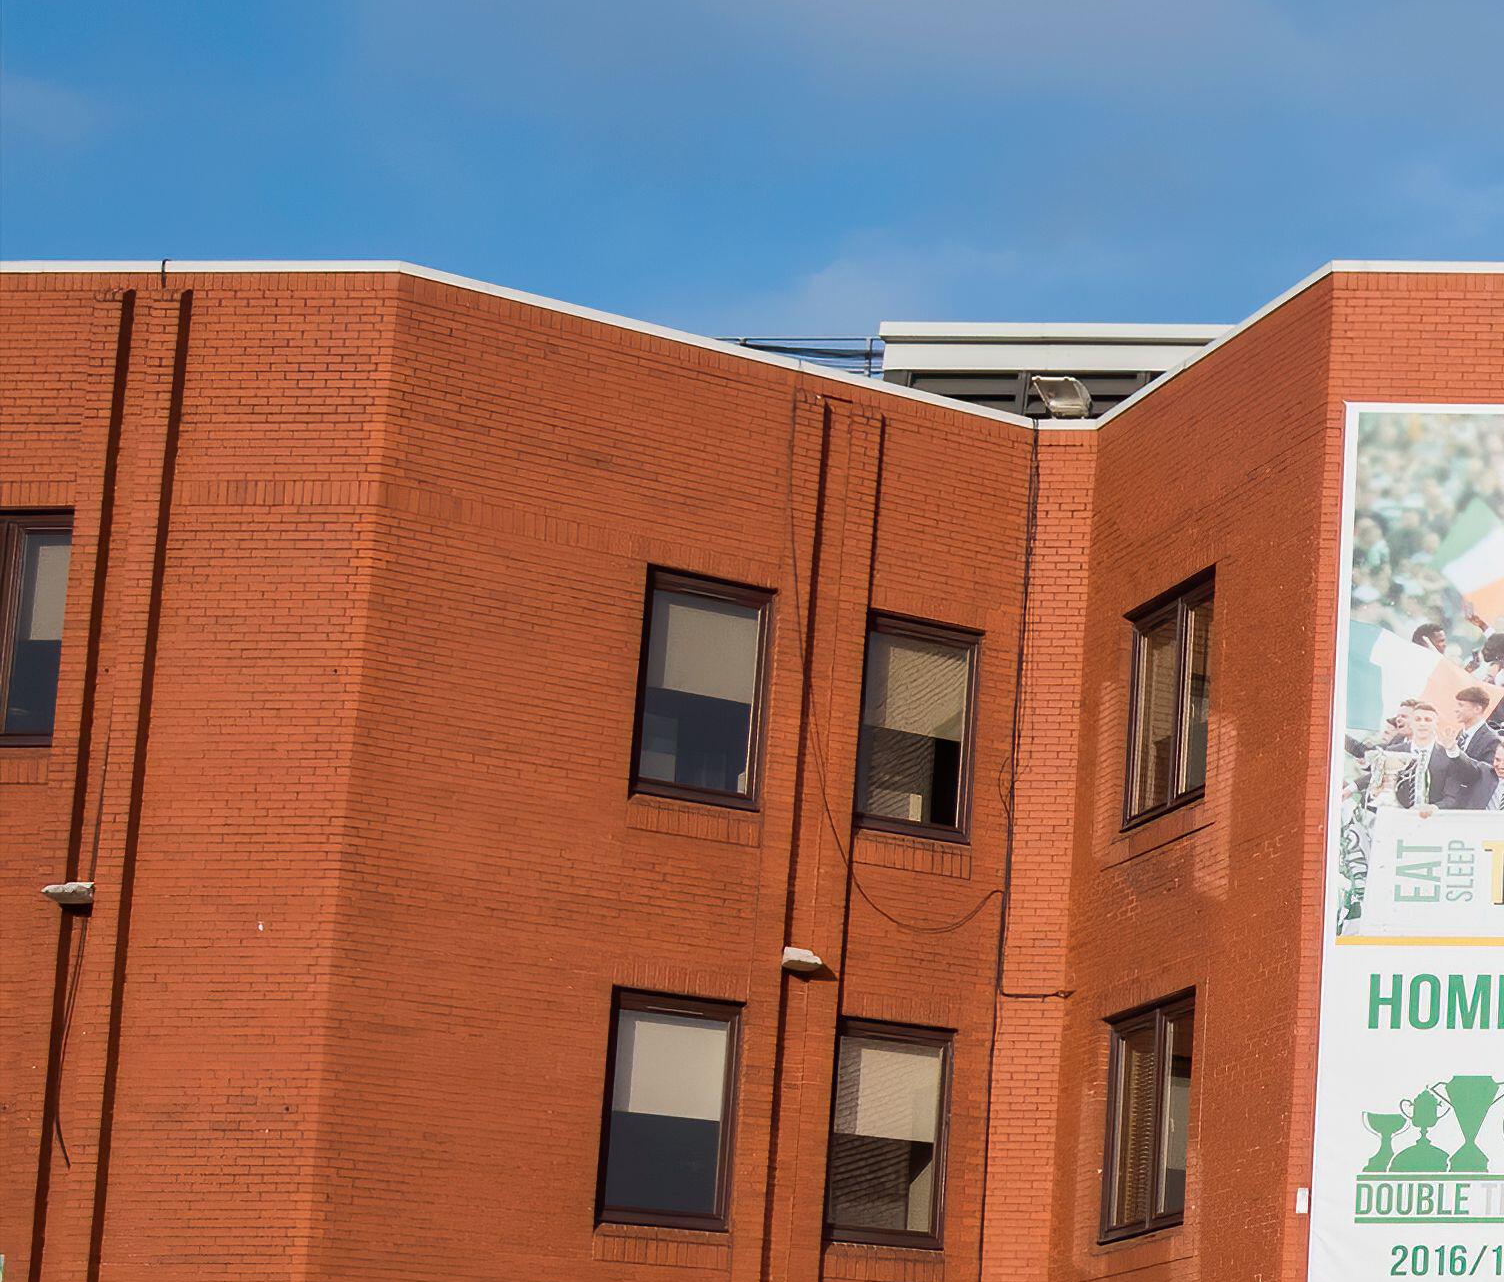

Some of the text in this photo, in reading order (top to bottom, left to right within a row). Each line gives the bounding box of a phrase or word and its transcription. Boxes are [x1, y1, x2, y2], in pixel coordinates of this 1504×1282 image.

[1393, 839, 1443, 903] EAT
[1445, 839, 1476, 902] SLEEP
[1355, 1182, 1471, 1216] DOUBLE
